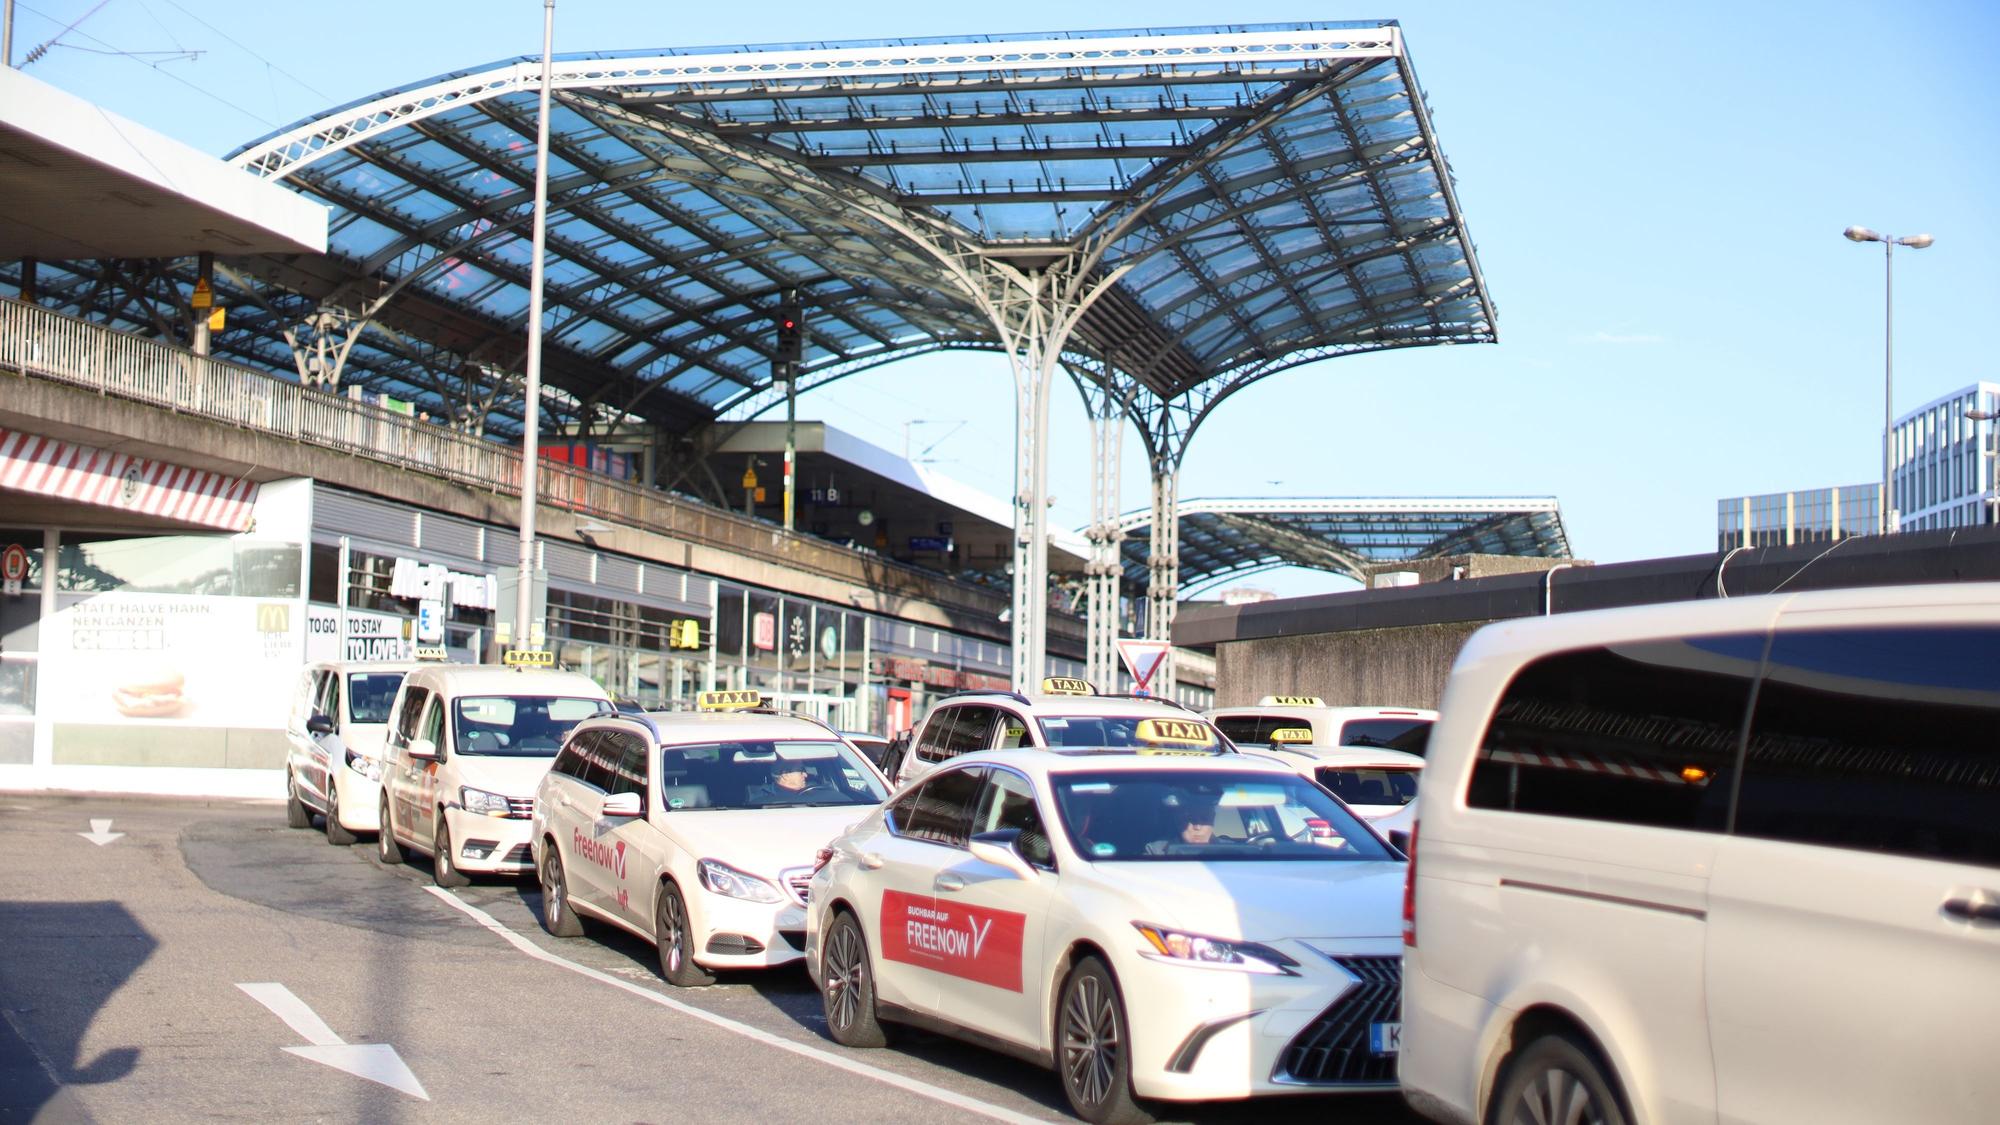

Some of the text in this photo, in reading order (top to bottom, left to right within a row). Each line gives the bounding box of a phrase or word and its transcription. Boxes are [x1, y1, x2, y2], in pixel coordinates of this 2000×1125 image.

[827, 488, 838, 501] B
[73, 603, 115, 614] STATT
[120, 603, 166, 614] HALVE
[72, 616, 165, 627] NEN GANZEN
[309, 618, 320, 633] TO
[348, 619, 382, 634] TO STAY
[348, 638, 365, 660] TO
[514, 652, 546, 662] TAXI
[1055, 679, 1084, 690] TAXI
[711, 691, 752, 704] TAXI
[1276, 696, 1311, 705] TAXI
[1156, 720, 1205, 740] TAXI
[1282, 730, 1308, 739] TAXI
[908, 905, 949, 922] BUCHBAR AUF
[1390, 1025, 1401, 1049] K
